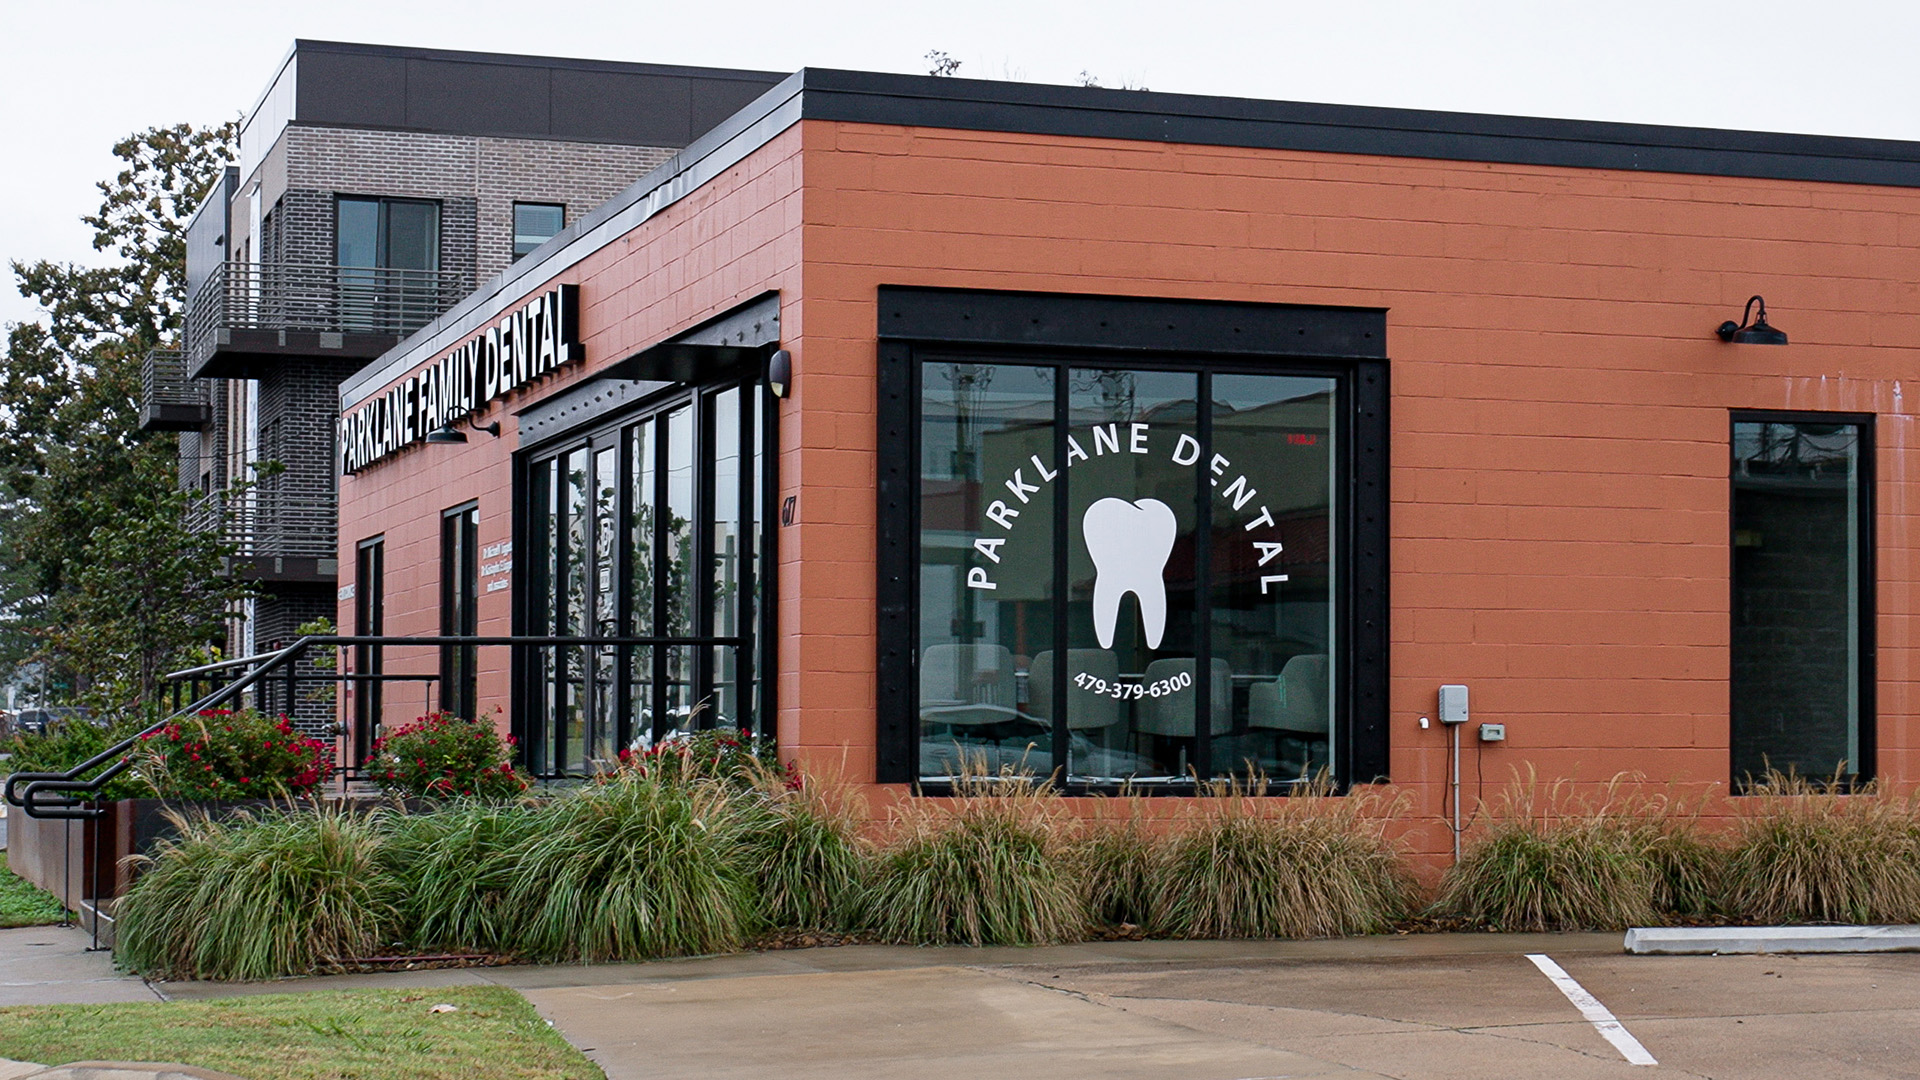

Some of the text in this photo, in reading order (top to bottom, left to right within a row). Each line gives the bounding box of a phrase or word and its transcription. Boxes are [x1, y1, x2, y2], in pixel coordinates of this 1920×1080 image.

[341, 283, 570, 476] PARKLANE FAMILY DENTAL
[967, 423, 1289, 595] PARKLANE DENTAL
[1073, 671, 1192, 700] 479-379-6300
